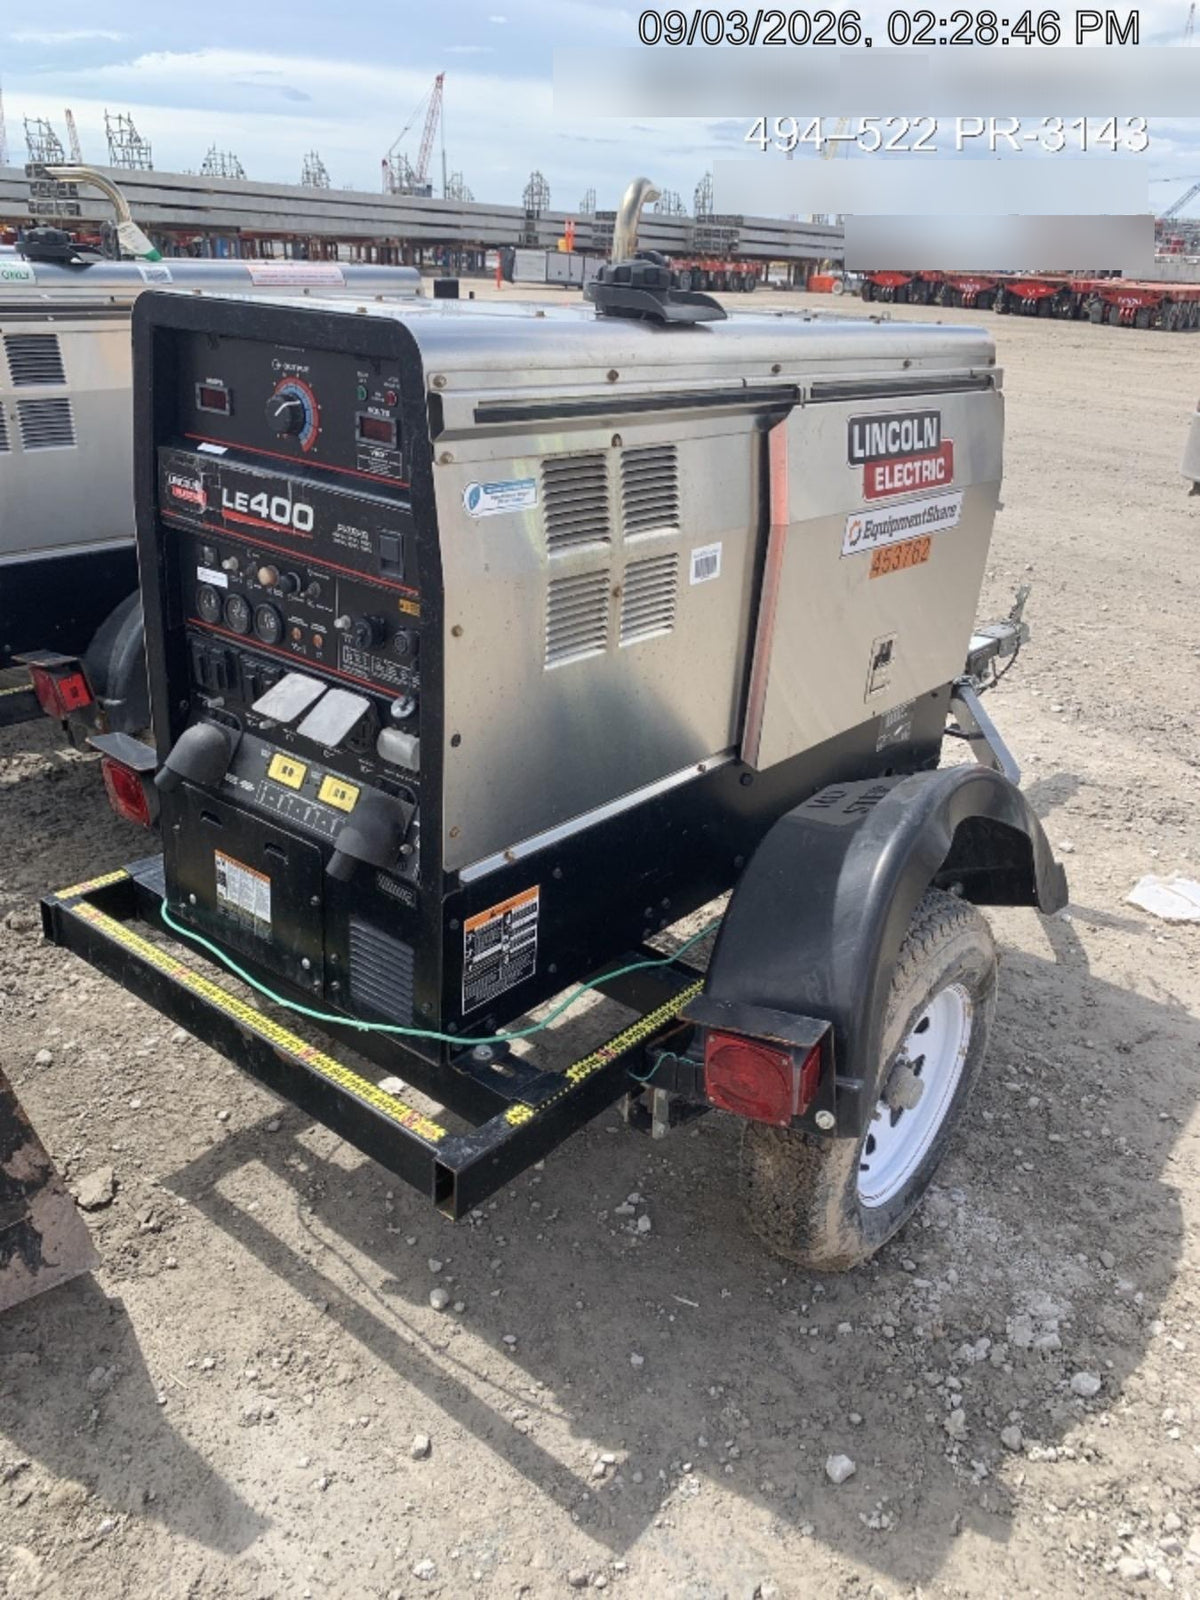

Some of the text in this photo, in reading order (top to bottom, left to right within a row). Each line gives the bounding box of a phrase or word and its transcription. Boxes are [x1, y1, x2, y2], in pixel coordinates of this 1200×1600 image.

[852, 416, 938, 458] LINCOLN
[875, 457, 946, 492] ELECTRIC
[221, 488, 314, 532] LE400
[862, 504, 960, 541] EquipmentShare
